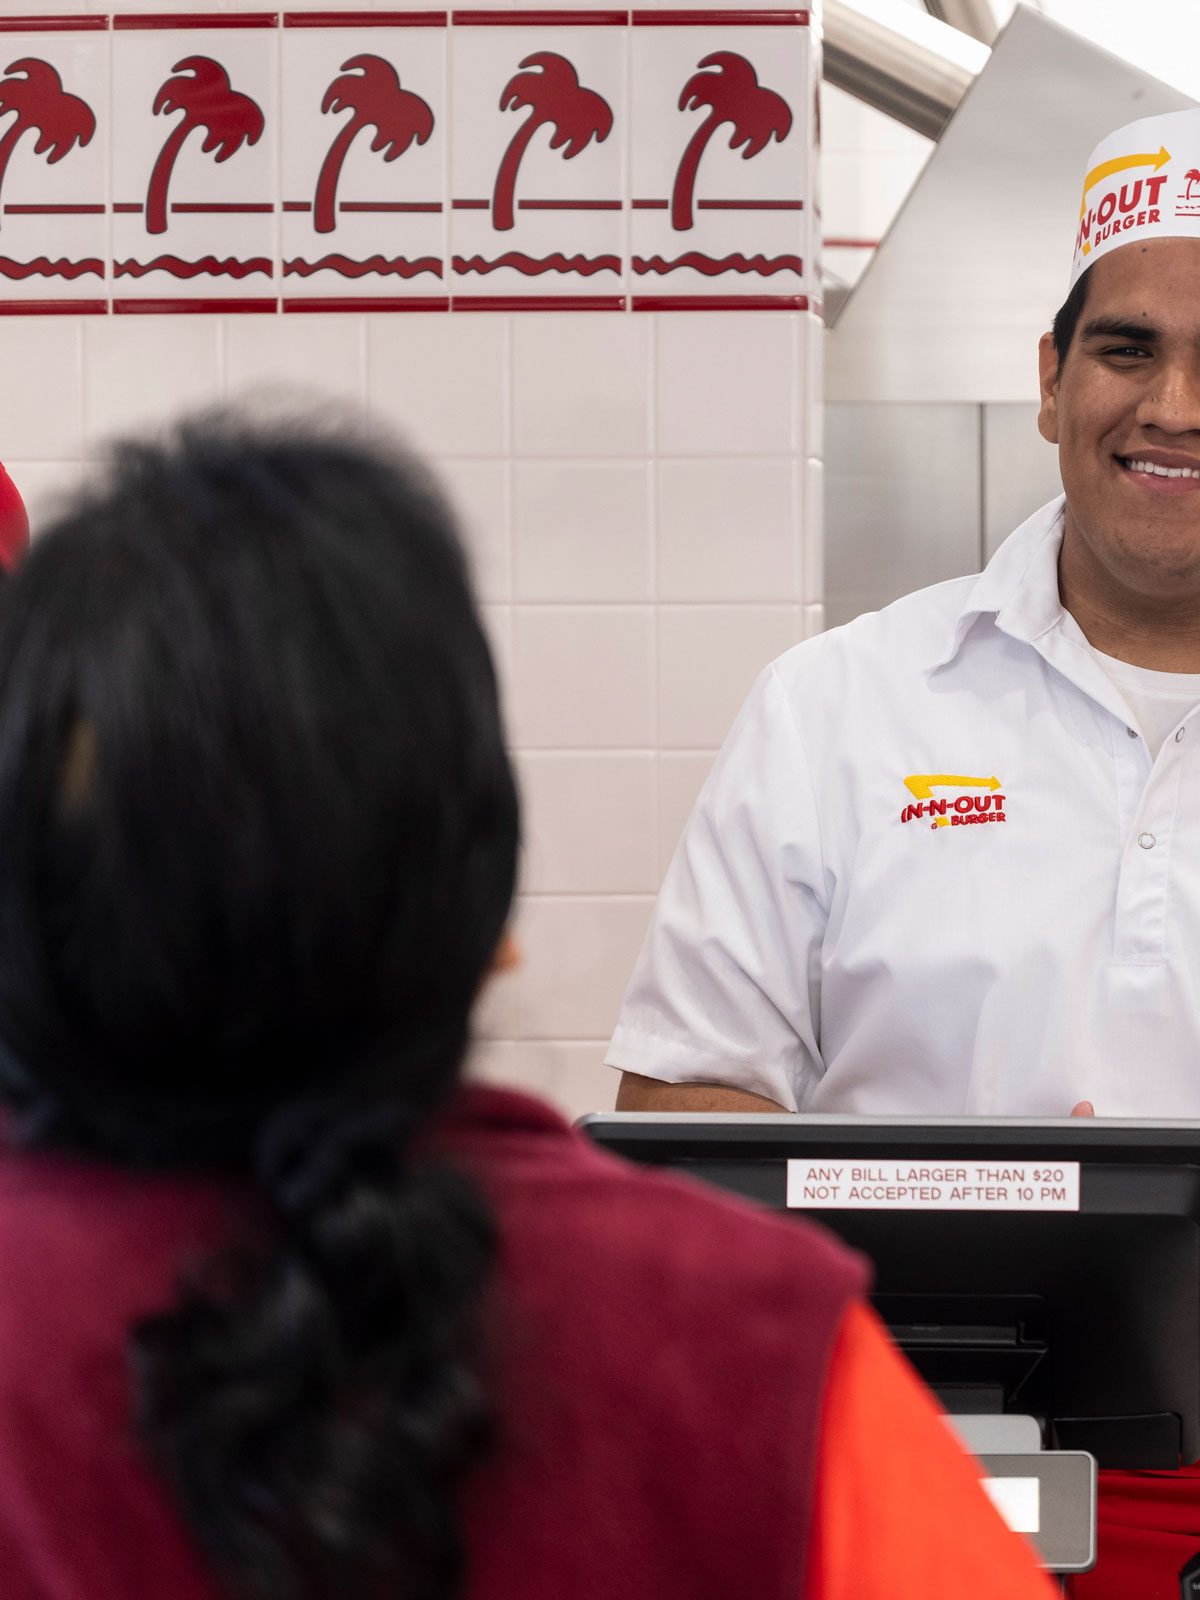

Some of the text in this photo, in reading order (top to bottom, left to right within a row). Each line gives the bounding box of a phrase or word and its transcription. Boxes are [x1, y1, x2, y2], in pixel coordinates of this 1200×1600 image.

[1095, 209, 1161, 247] BURGER
[901, 795, 1006, 823] IN-N-OUT
[951, 812, 1006, 826] BURGER
[807, 1168, 1064, 1183] ANY BILL LARGER THAN $20
[803, 1186, 1067, 1201] NOT ACCEPTED AFTER 10 PM
